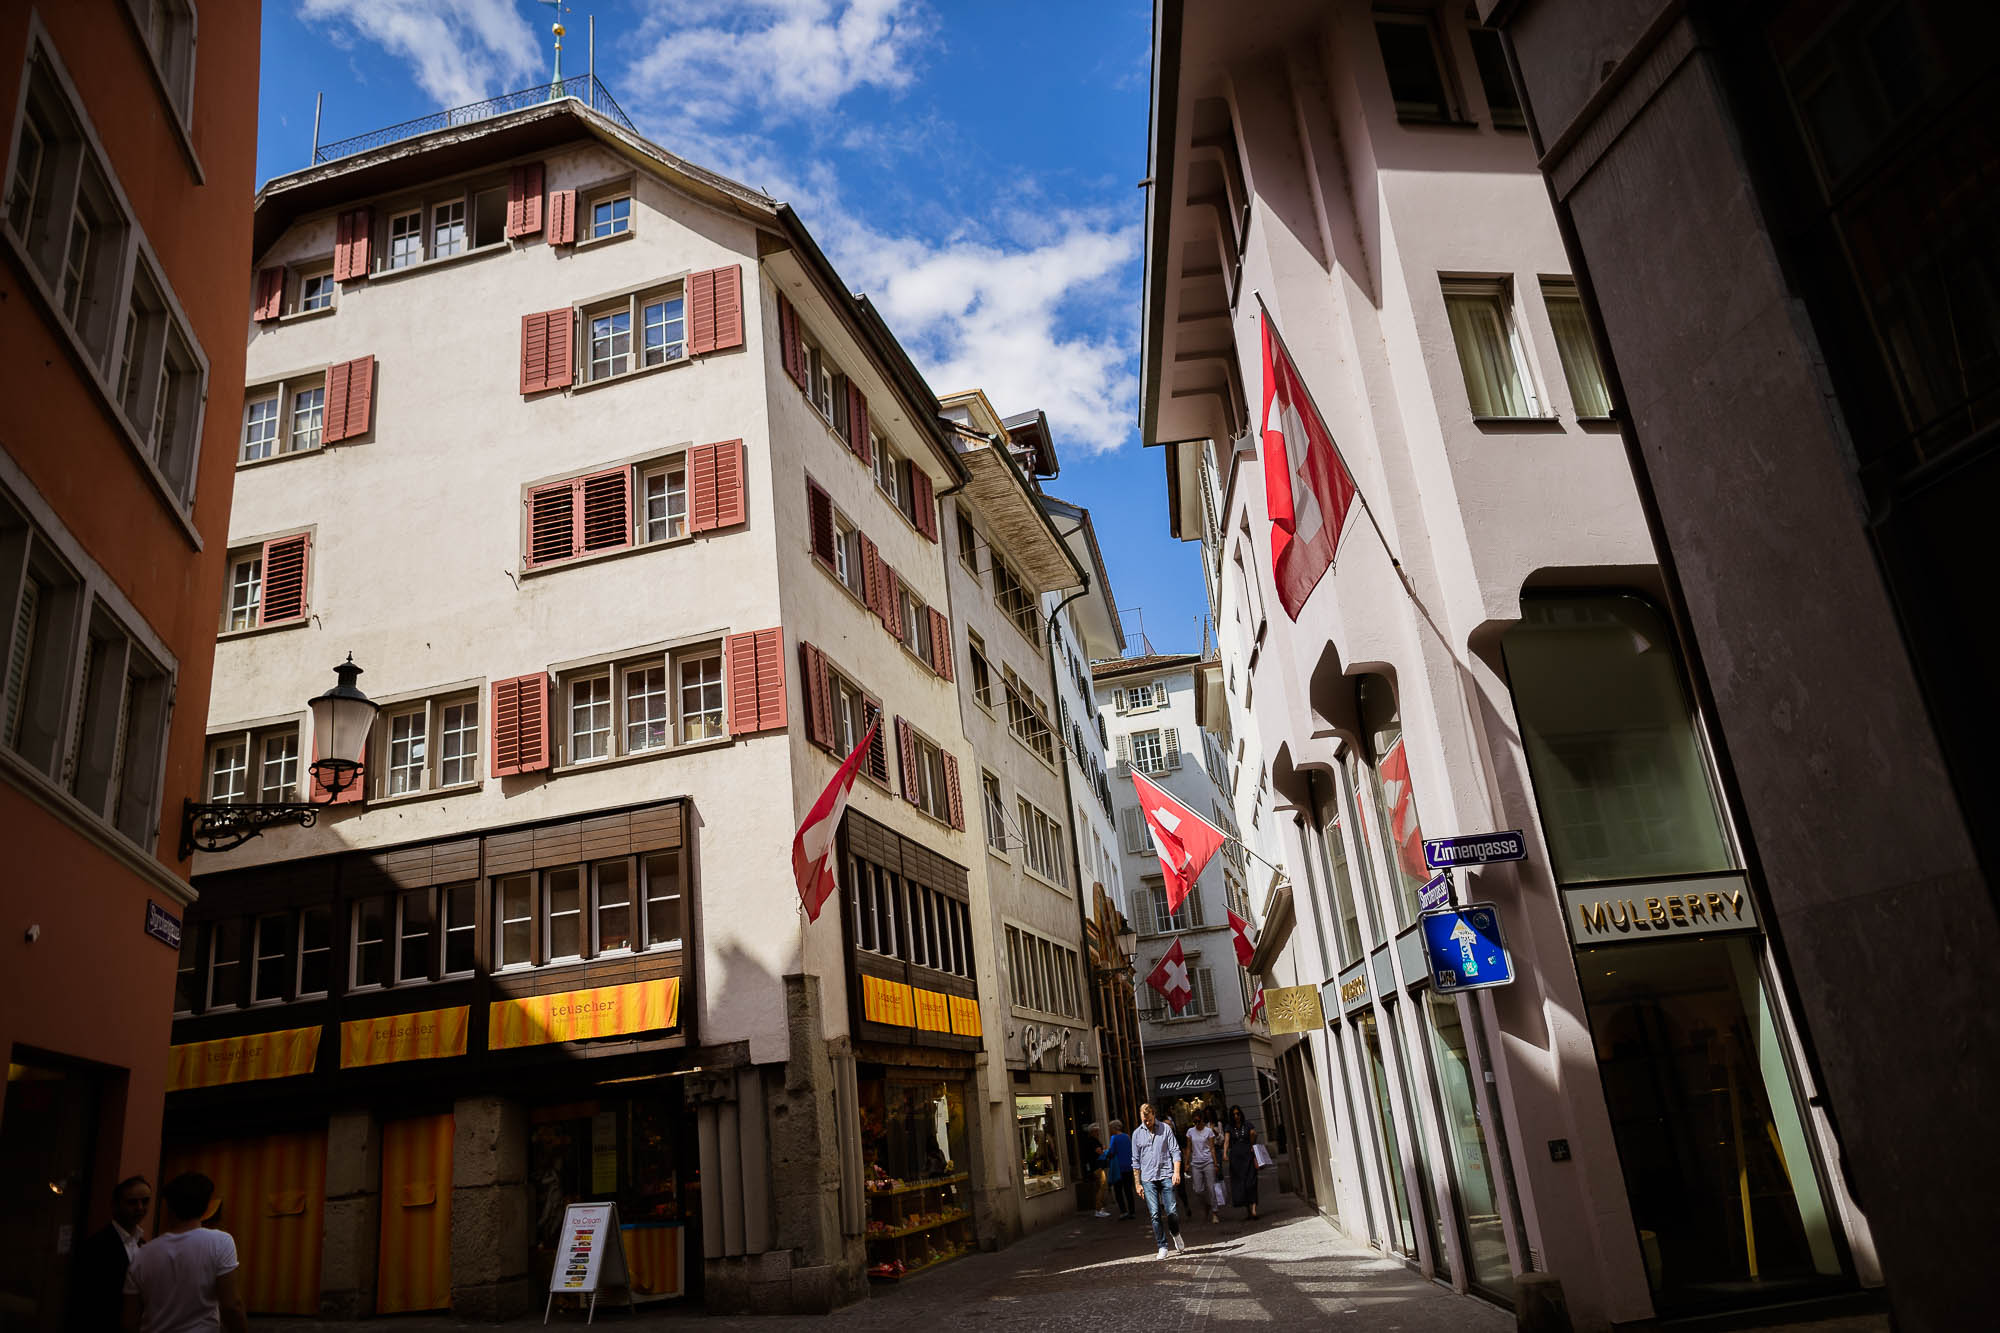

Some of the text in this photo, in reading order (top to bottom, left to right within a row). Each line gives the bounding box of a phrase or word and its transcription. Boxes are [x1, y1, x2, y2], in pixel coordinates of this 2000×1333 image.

[1431, 839, 1518, 862] Zinnengasse
[1579, 890, 1741, 930] MULBERRY
[552, 1001, 615, 1017] teuscher
[376, 1024, 436, 1040] teuscher
[1160, 1080, 1181, 1090] van
